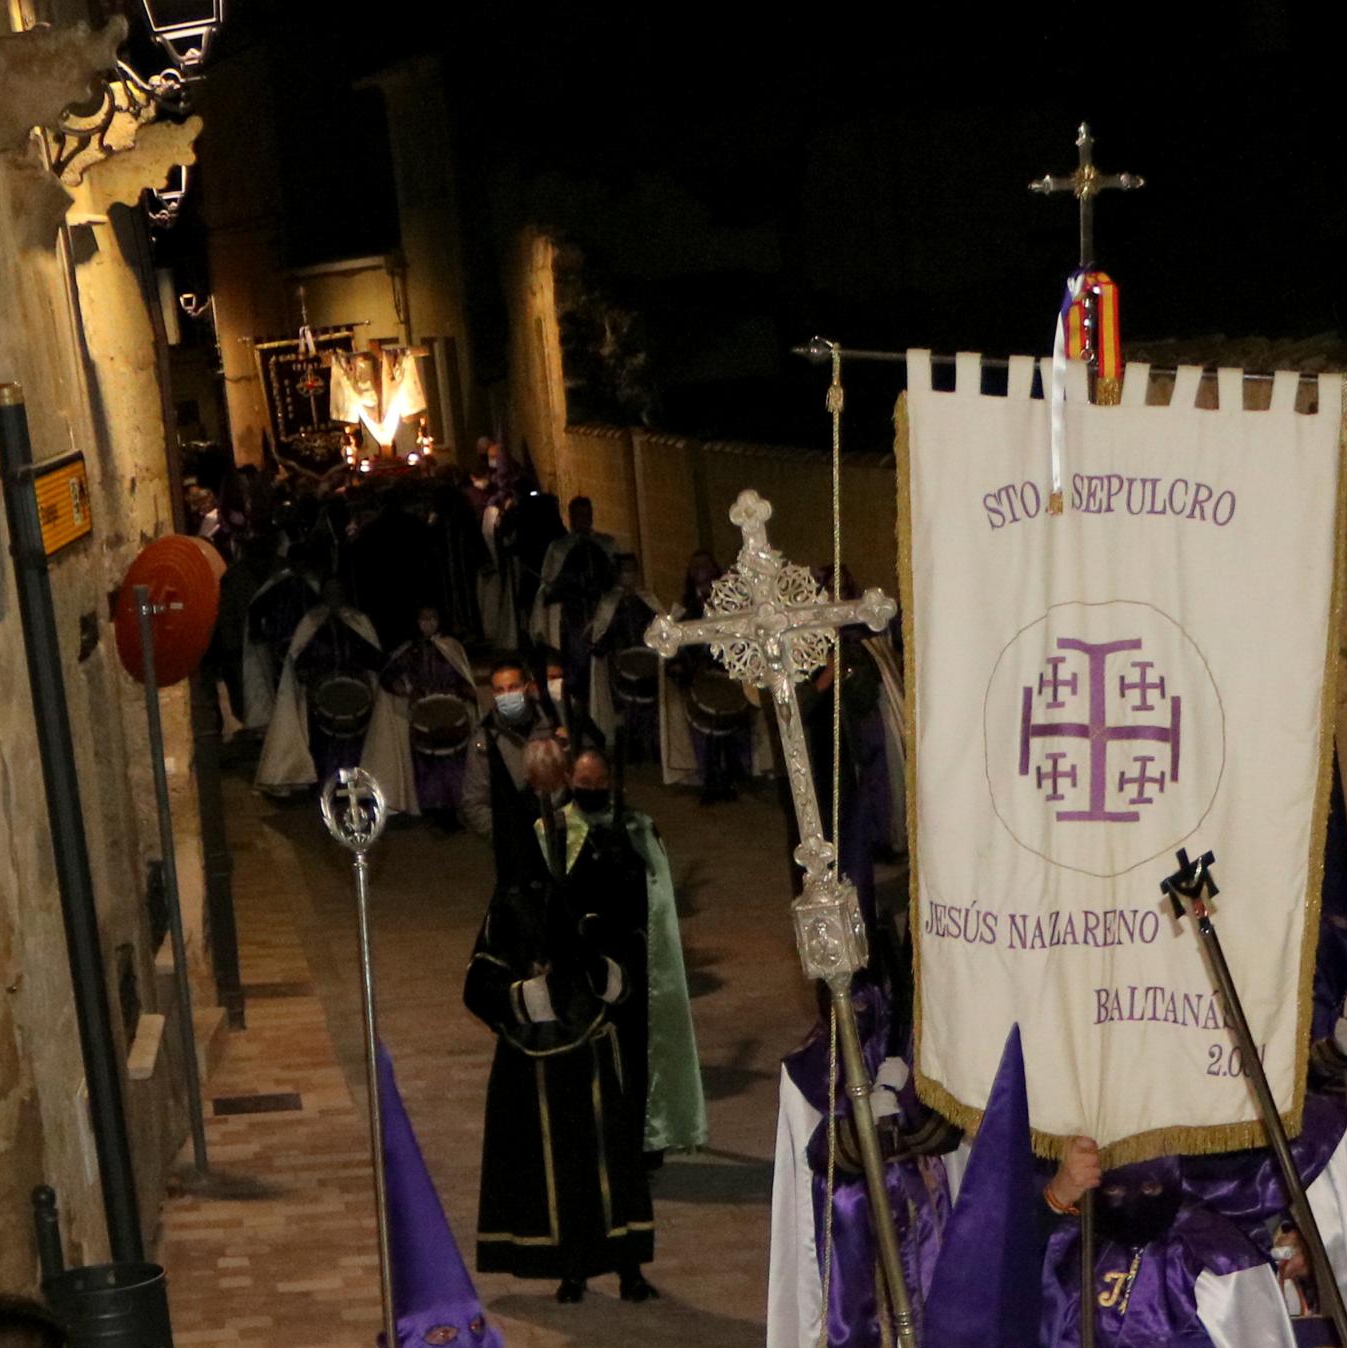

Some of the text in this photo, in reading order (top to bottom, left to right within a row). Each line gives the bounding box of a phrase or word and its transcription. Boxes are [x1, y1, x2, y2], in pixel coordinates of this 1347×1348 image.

[1071, 473, 1237, 527] SEPULCRO
[925, 901, 1160, 950] JESÚS NAZARENO
